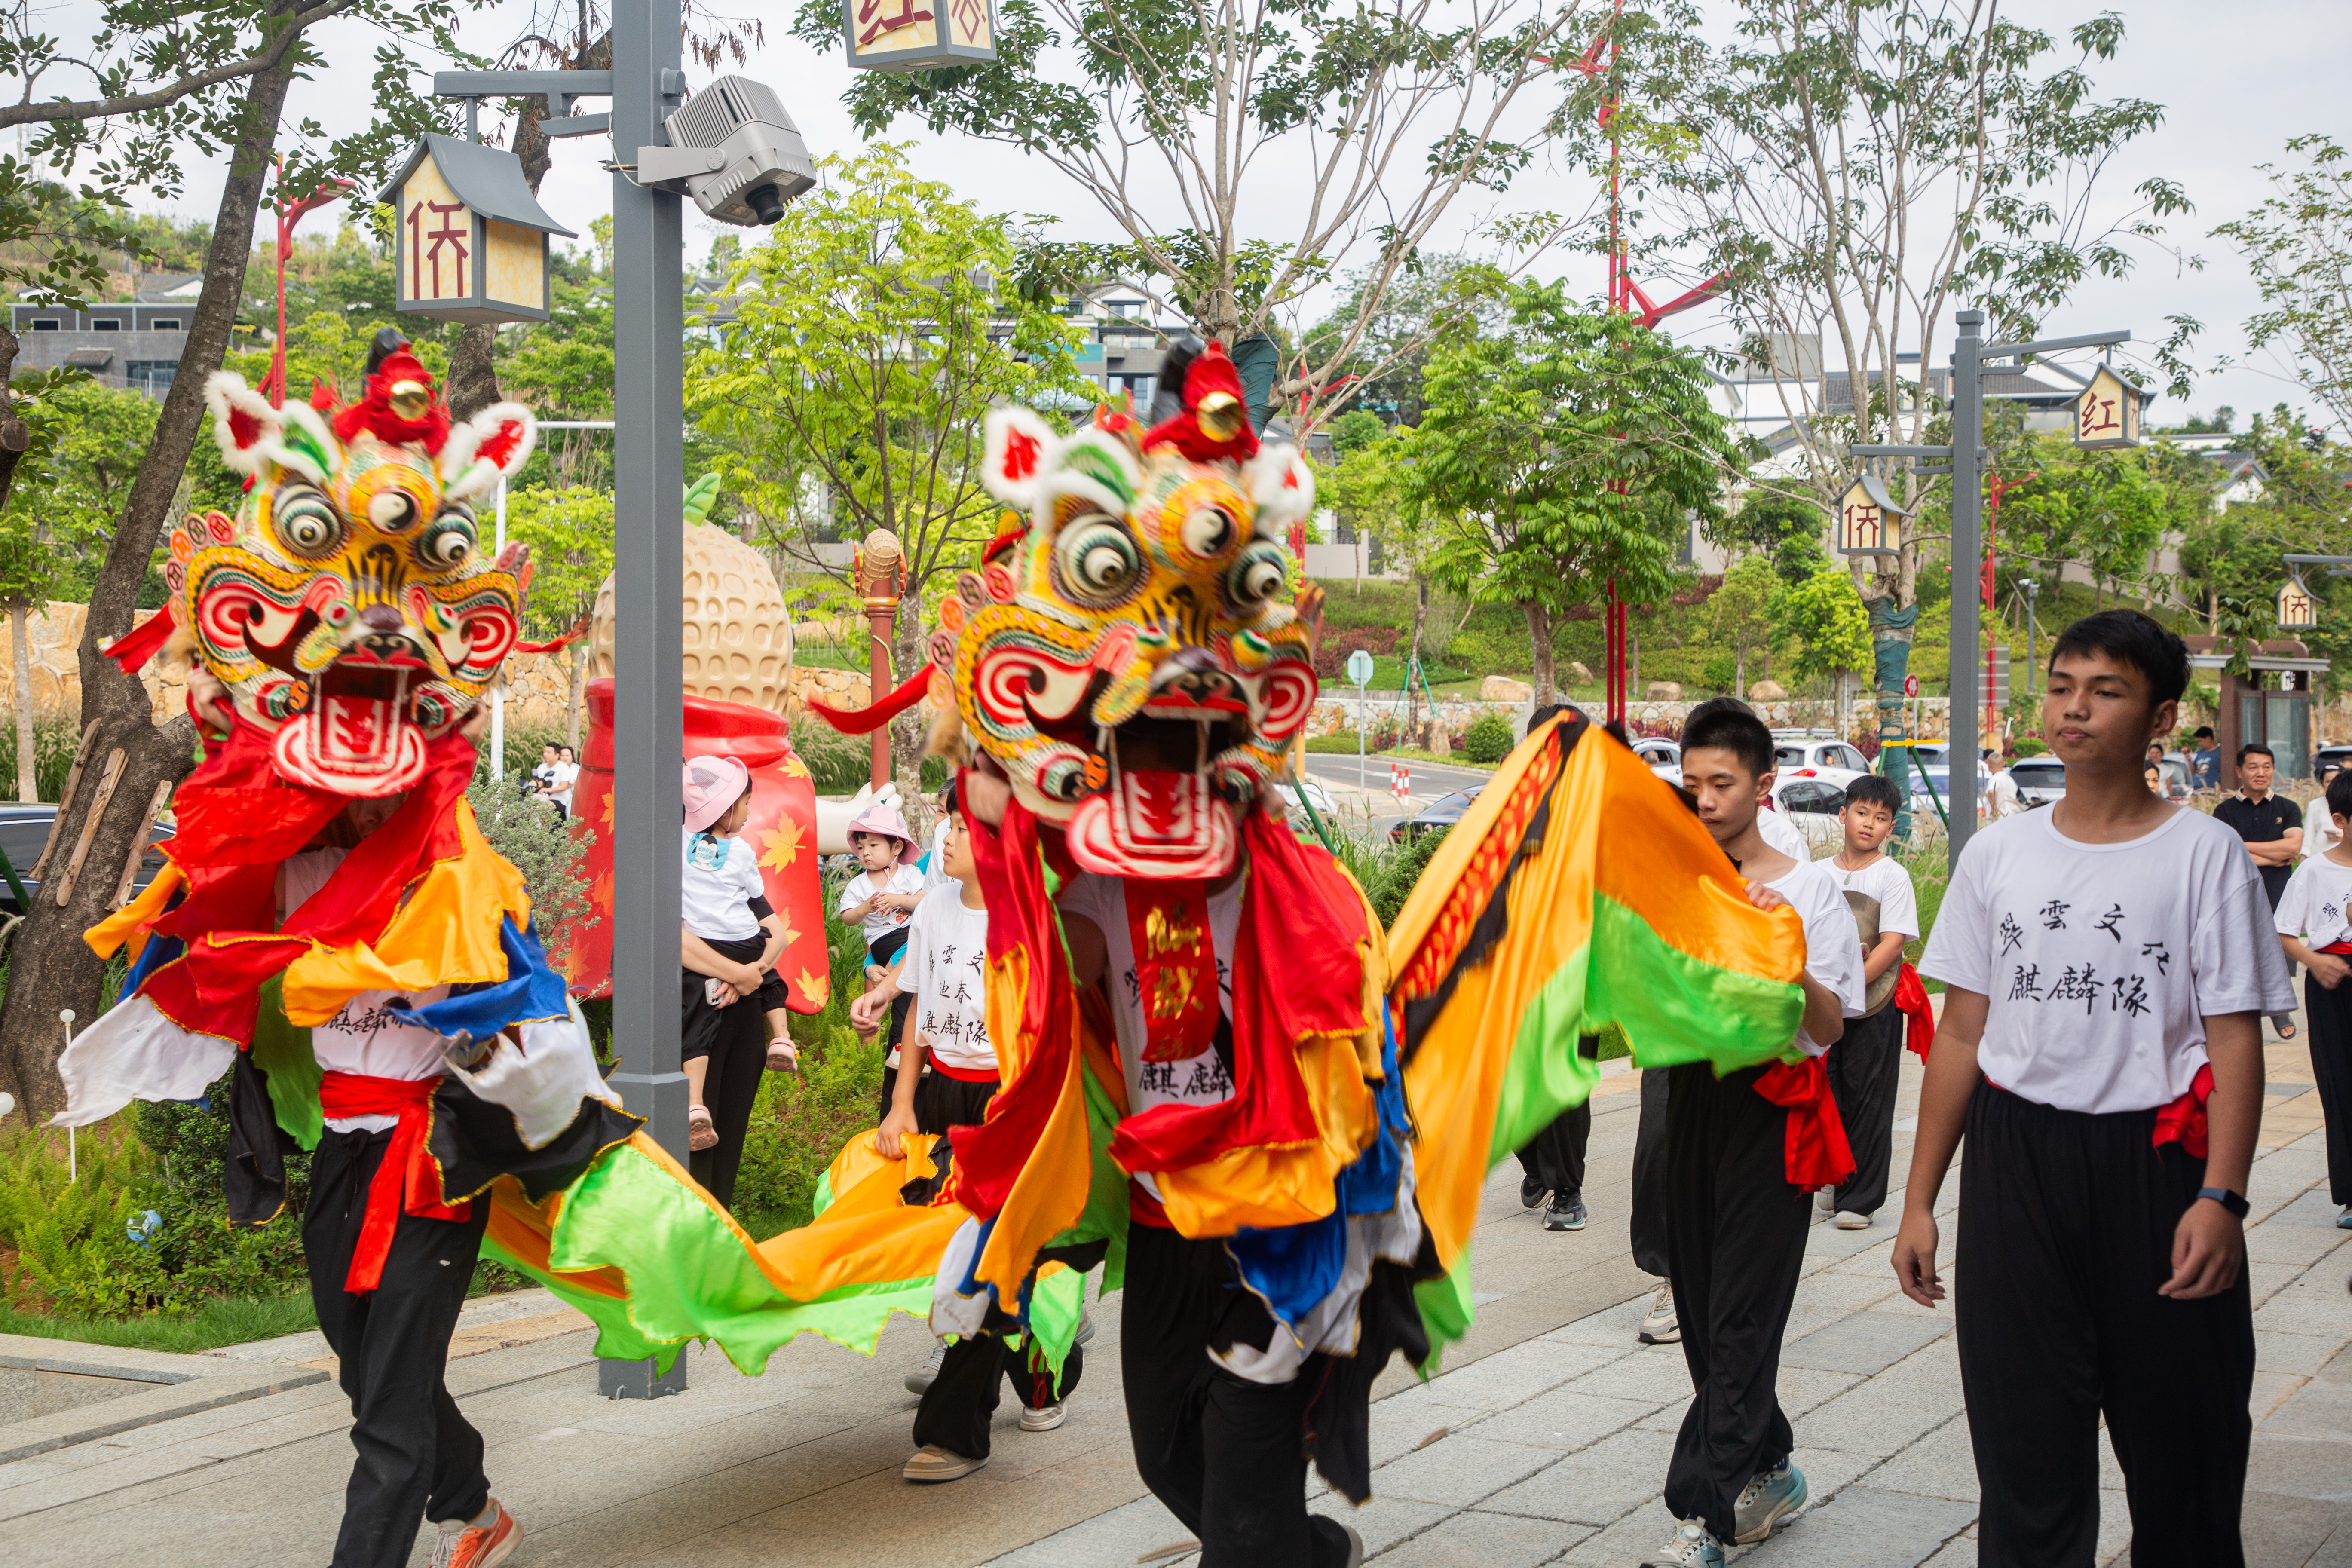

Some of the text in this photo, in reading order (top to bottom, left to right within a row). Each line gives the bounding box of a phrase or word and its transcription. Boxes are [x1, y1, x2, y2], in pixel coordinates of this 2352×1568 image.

[2081, 392, 2120, 437] 红
[2007, 962, 2151, 1017] 麒麟隊
